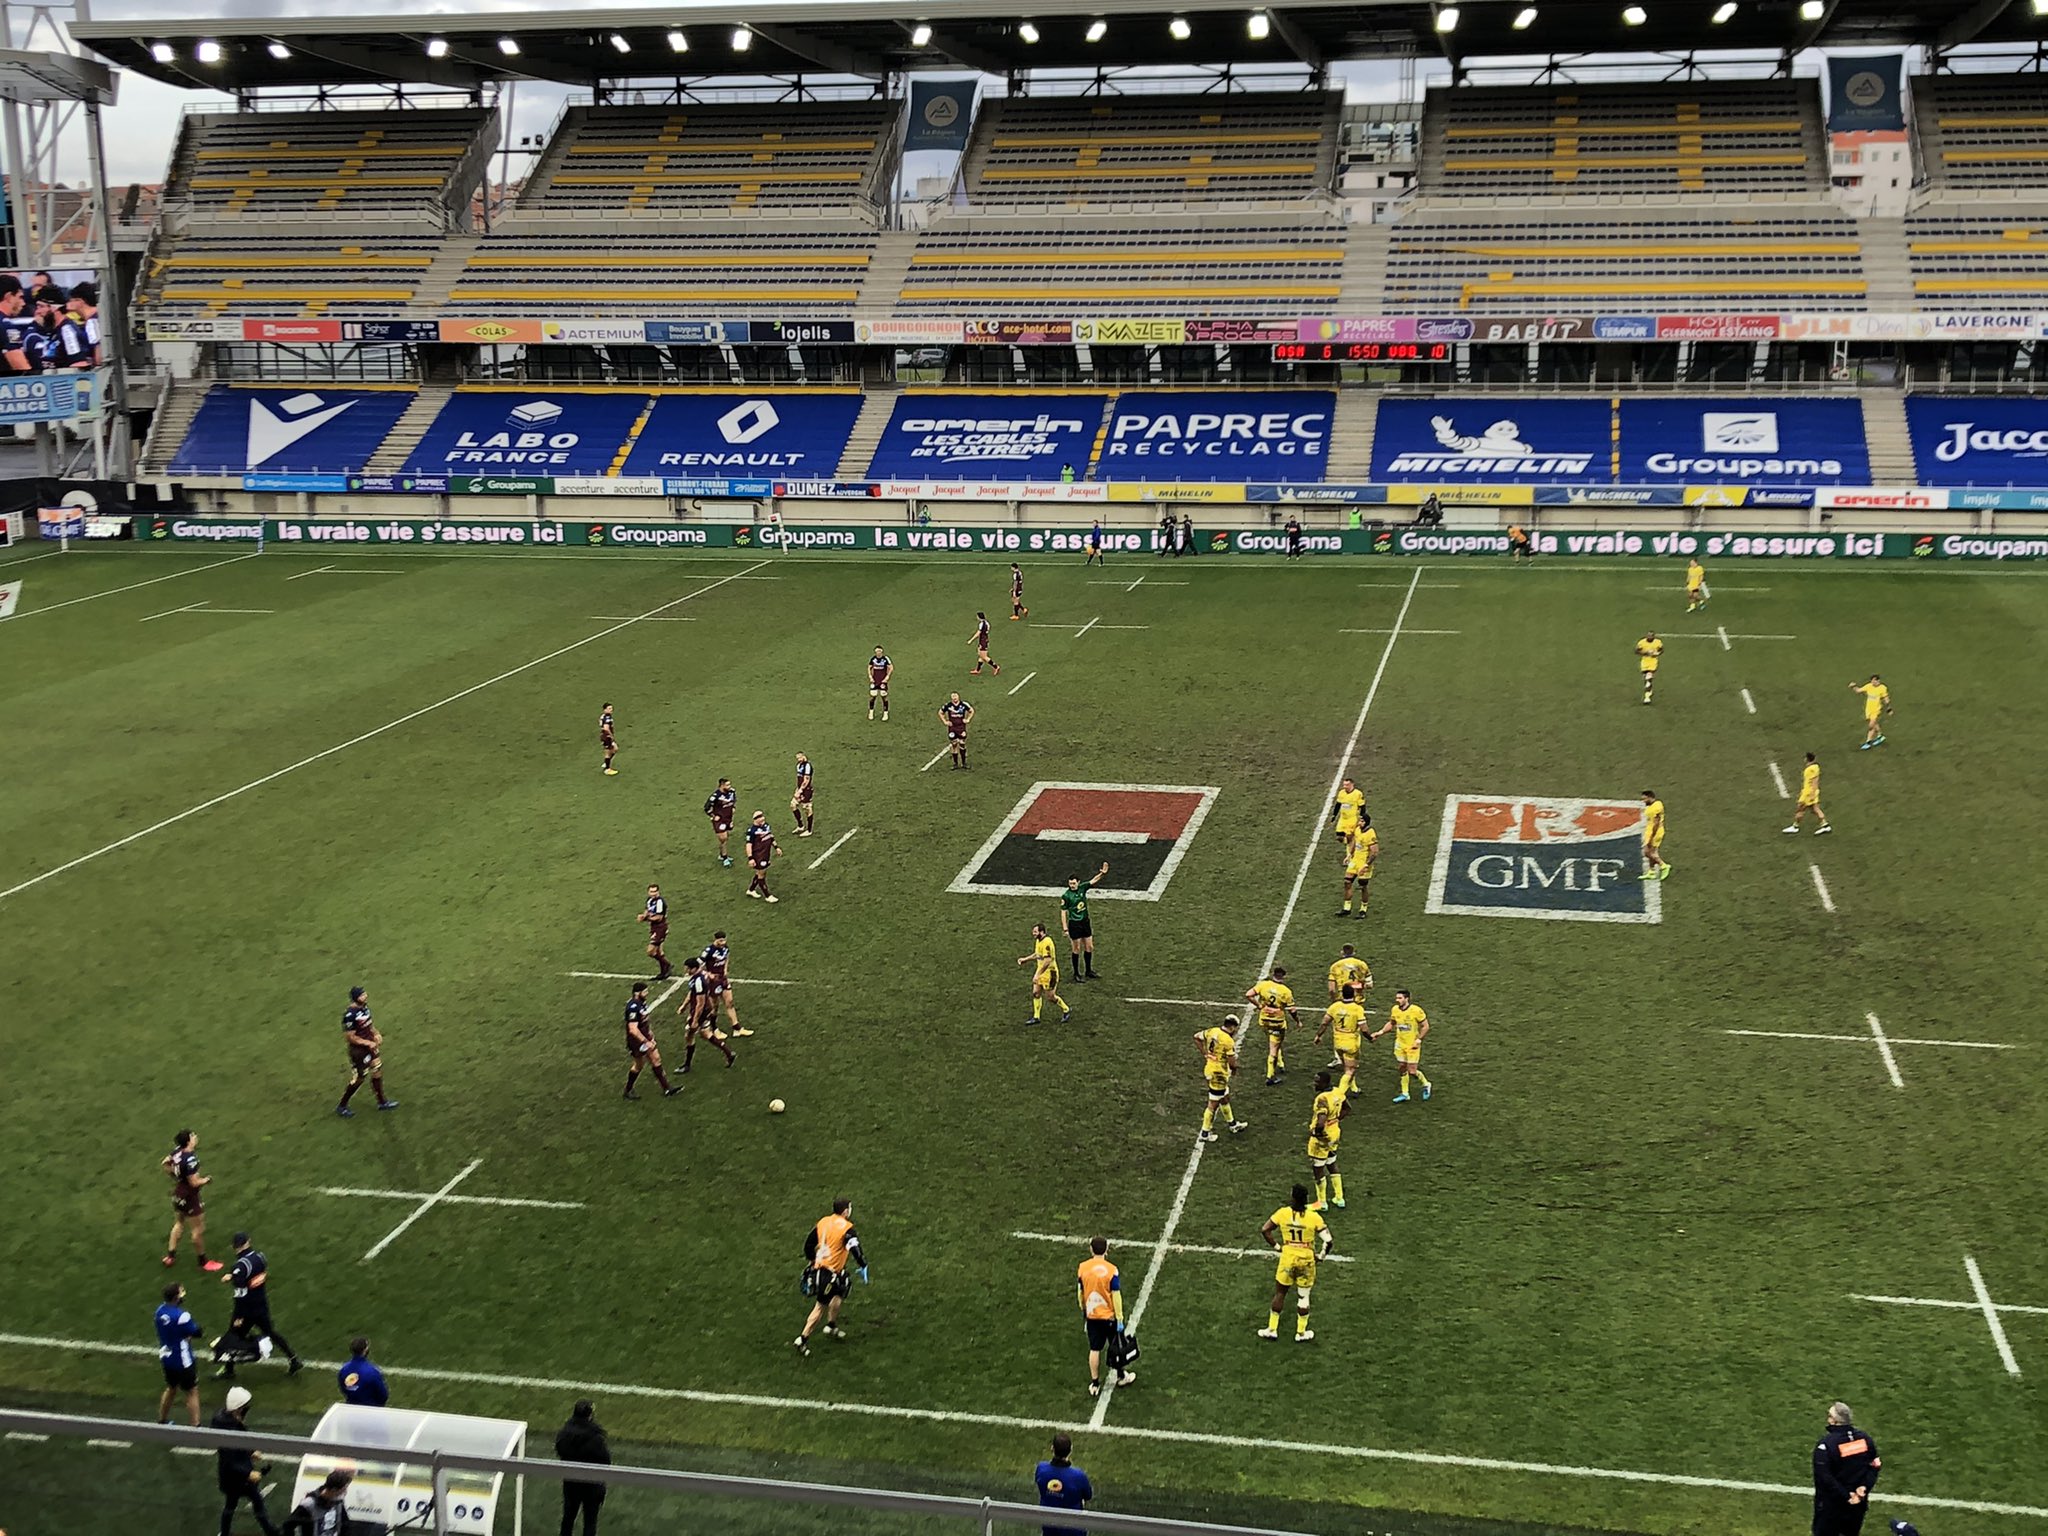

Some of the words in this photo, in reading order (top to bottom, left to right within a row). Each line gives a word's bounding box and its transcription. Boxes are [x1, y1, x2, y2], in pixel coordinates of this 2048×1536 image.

[872, 322, 962, 333] BOURGOIGNON
[965, 320, 1000, 335] ace
[1185, 321, 1253, 331] ALPHA
[1343, 320, 1396, 332] PAPREC
[1935, 315, 2034, 328] LAVERGNE
[475, 327, 508, 336] COLAS
[568, 329, 644, 340] ACTEMIUM
[781, 325, 831, 342] lojelis
[1002, 323, 1072, 335] ace-hotel.com
[1098, 322, 1182, 341] MAZET
[1196, 331, 1297, 341] PROCESS
[1488, 322, 1574, 342] BABUT
[1601, 327, 1648, 338] TEMPUR
[1661, 328, 1717, 339] CLERMONT
[1719, 326, 1776, 338] ESTAING
[1323, 345, 1332, 359] 6
[1430, 345, 1445, 358] 10
[0, 383, 47, 400] ABO
[901, 414, 1084, 433] omerin
[1112, 413, 1326, 440] PAPREC
[455, 432, 580, 449] LABO
[922, 434, 963, 447] LES
[963, 433, 1050, 445] CABLES
[910, 448, 936, 458] DE
[936, 442, 1059, 458] L'EXTREME
[1108, 441, 1323, 456] RECYCLAGE
[443, 451, 571, 465] FRANCE
[659, 452, 806, 466] RENAULT
[1386, 459, 1591, 474] MICHELIN
[1646, 453, 1843, 478] Groupama
[487, 480, 537, 492] Groupama
[560, 485, 605, 494] accenture
[614, 485, 659, 494] accenture
[786, 483, 835, 496] DUMEZ
[887, 485, 920, 496] Jacquet
[931, 485, 965, 497] Jacquet
[975, 485, 1010, 497] Jacquet
[1022, 486, 1056, 498] Jacquet
[1068, 487, 1102, 498] Jacquet
[1158, 490, 1214, 498] MICHELIN
[1296, 490, 1358, 500] MICHELIN
[1588, 491, 1653, 501] MICHELIN
[1834, 491, 1930, 507] omerin
[1963, 493, 2001, 506] implid
[172, 521, 261, 541] Groupama
[278, 521, 303, 541] la
[308, 521, 370, 541] vraie
[376, 521, 414, 541] vie
[531, 522, 564, 543] ici
[611, 525, 707, 546] Groupama
[759, 527, 855, 548] Groupama
[874, 527, 898, 547] la
[907, 528, 973, 549] vraie
[982, 528, 1021, 549] vie
[1400, 532, 1510, 555] Groupama
[1531, 531, 1558, 553] la
[1567, 531, 1643, 555] vraie
[1652, 532, 1698, 555] vie
[1844, 533, 1885, 557] ici
[1943, 535, 2048, 560] Groupam
[1467, 854, 1625, 893] GMF
[1288, 1229, 1303, 1242] 11
